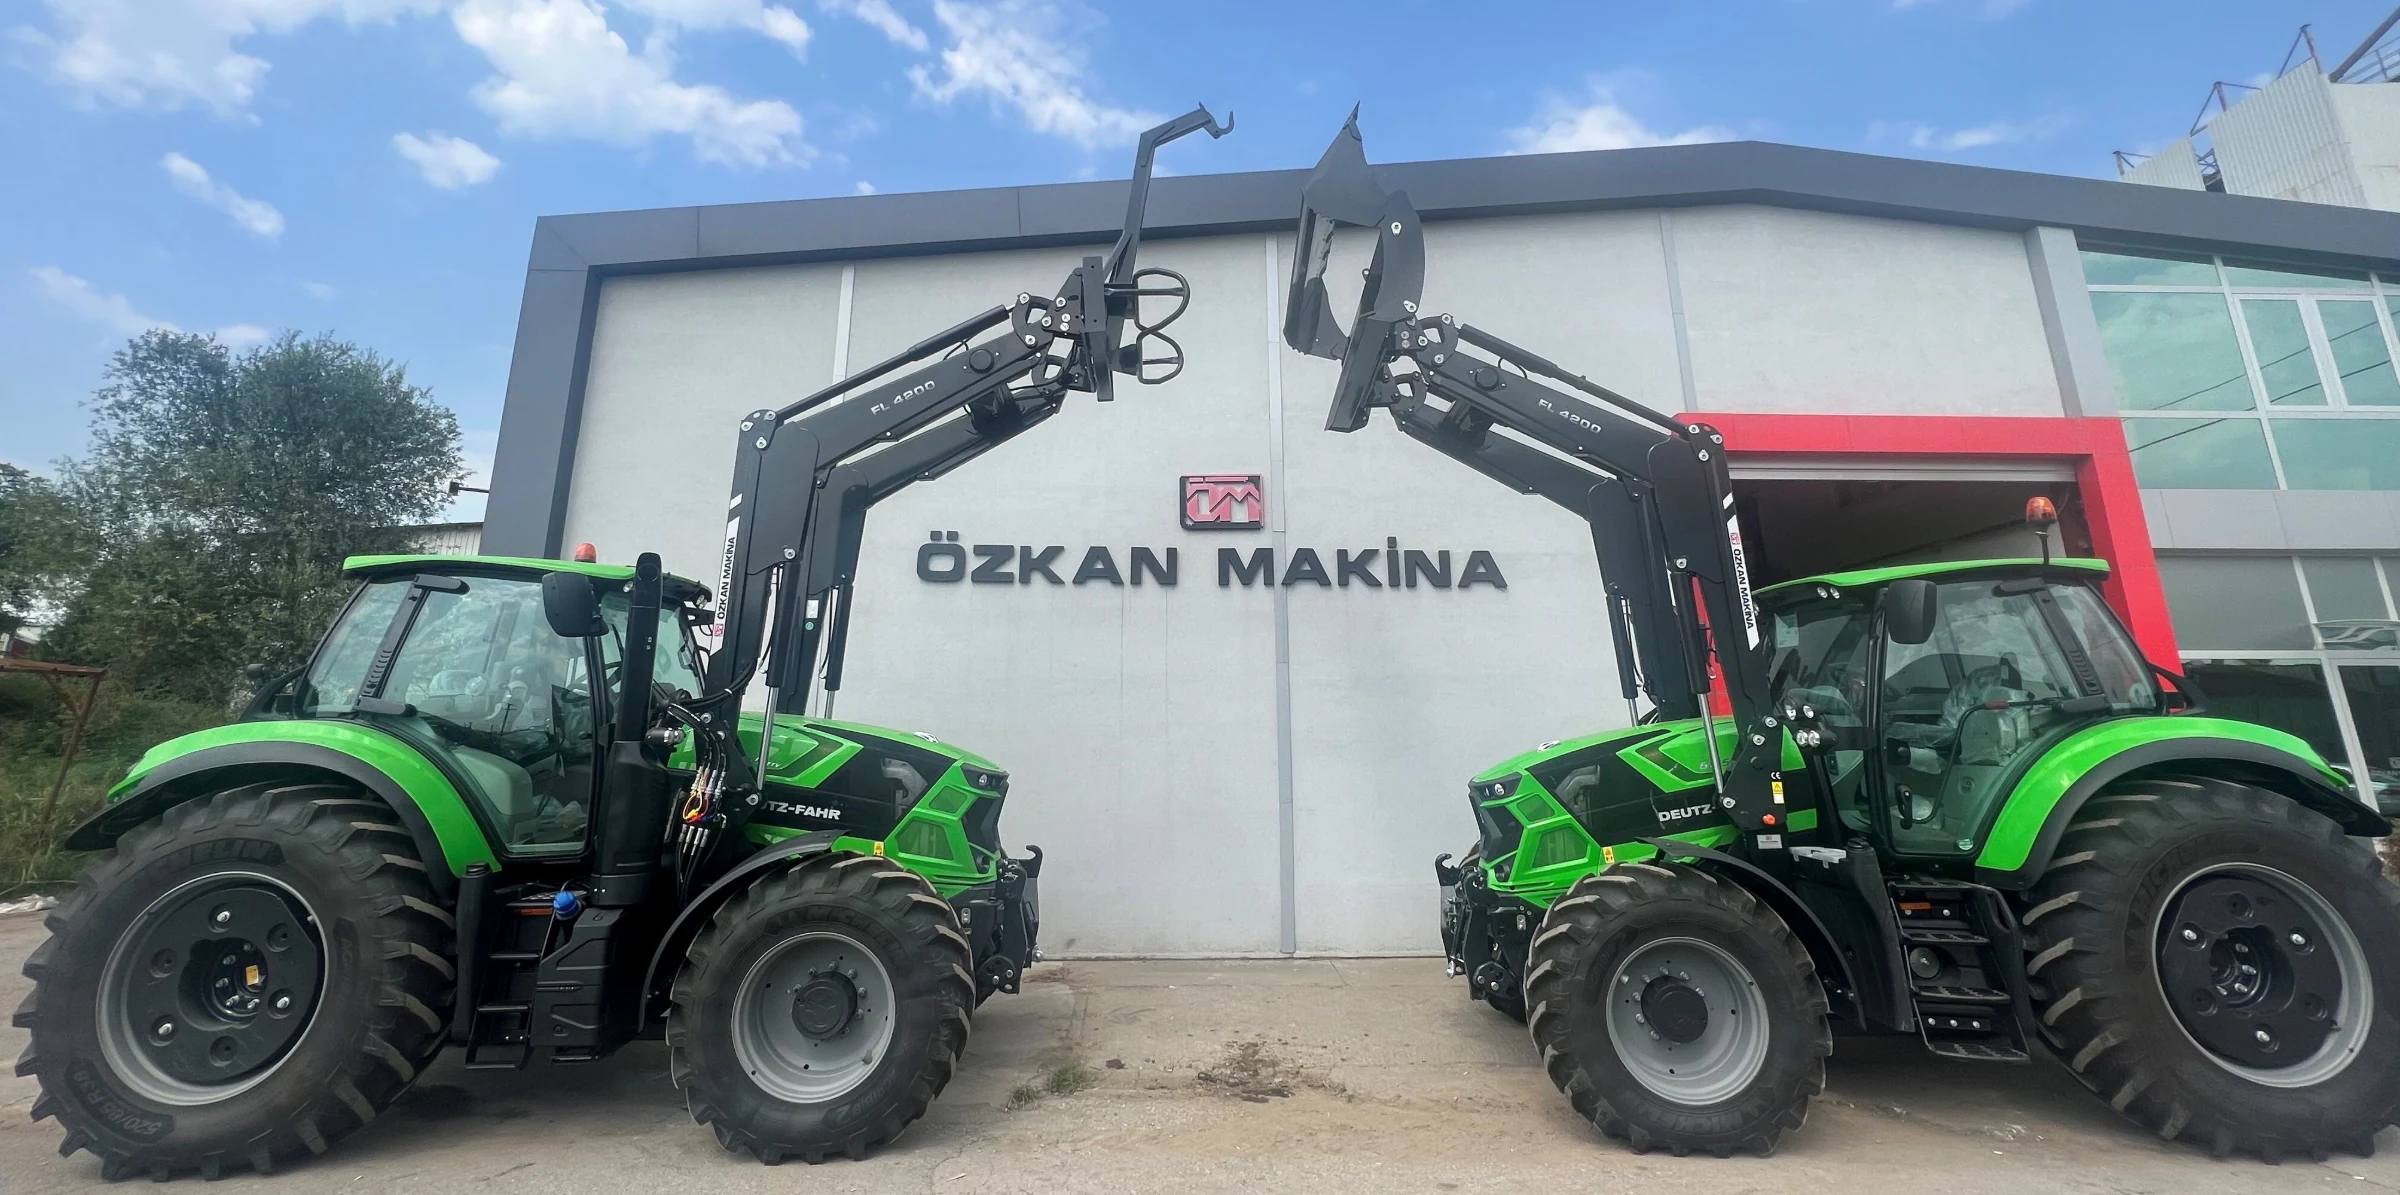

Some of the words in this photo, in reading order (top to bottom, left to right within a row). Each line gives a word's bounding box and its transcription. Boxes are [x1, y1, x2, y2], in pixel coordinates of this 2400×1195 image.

[870, 403, 890, 415] FL
[893, 380, 936, 404] 4200
[1538, 398, 1555, 413] FL
[1559, 410, 1602, 434] 4200
[722, 537, 736, 579] MAKİNA
[916, 530, 1178, 586] ÖZKAN
[1217, 536, 1508, 589] MAKİNA
[716, 582, 729, 620] ÖZKAN
